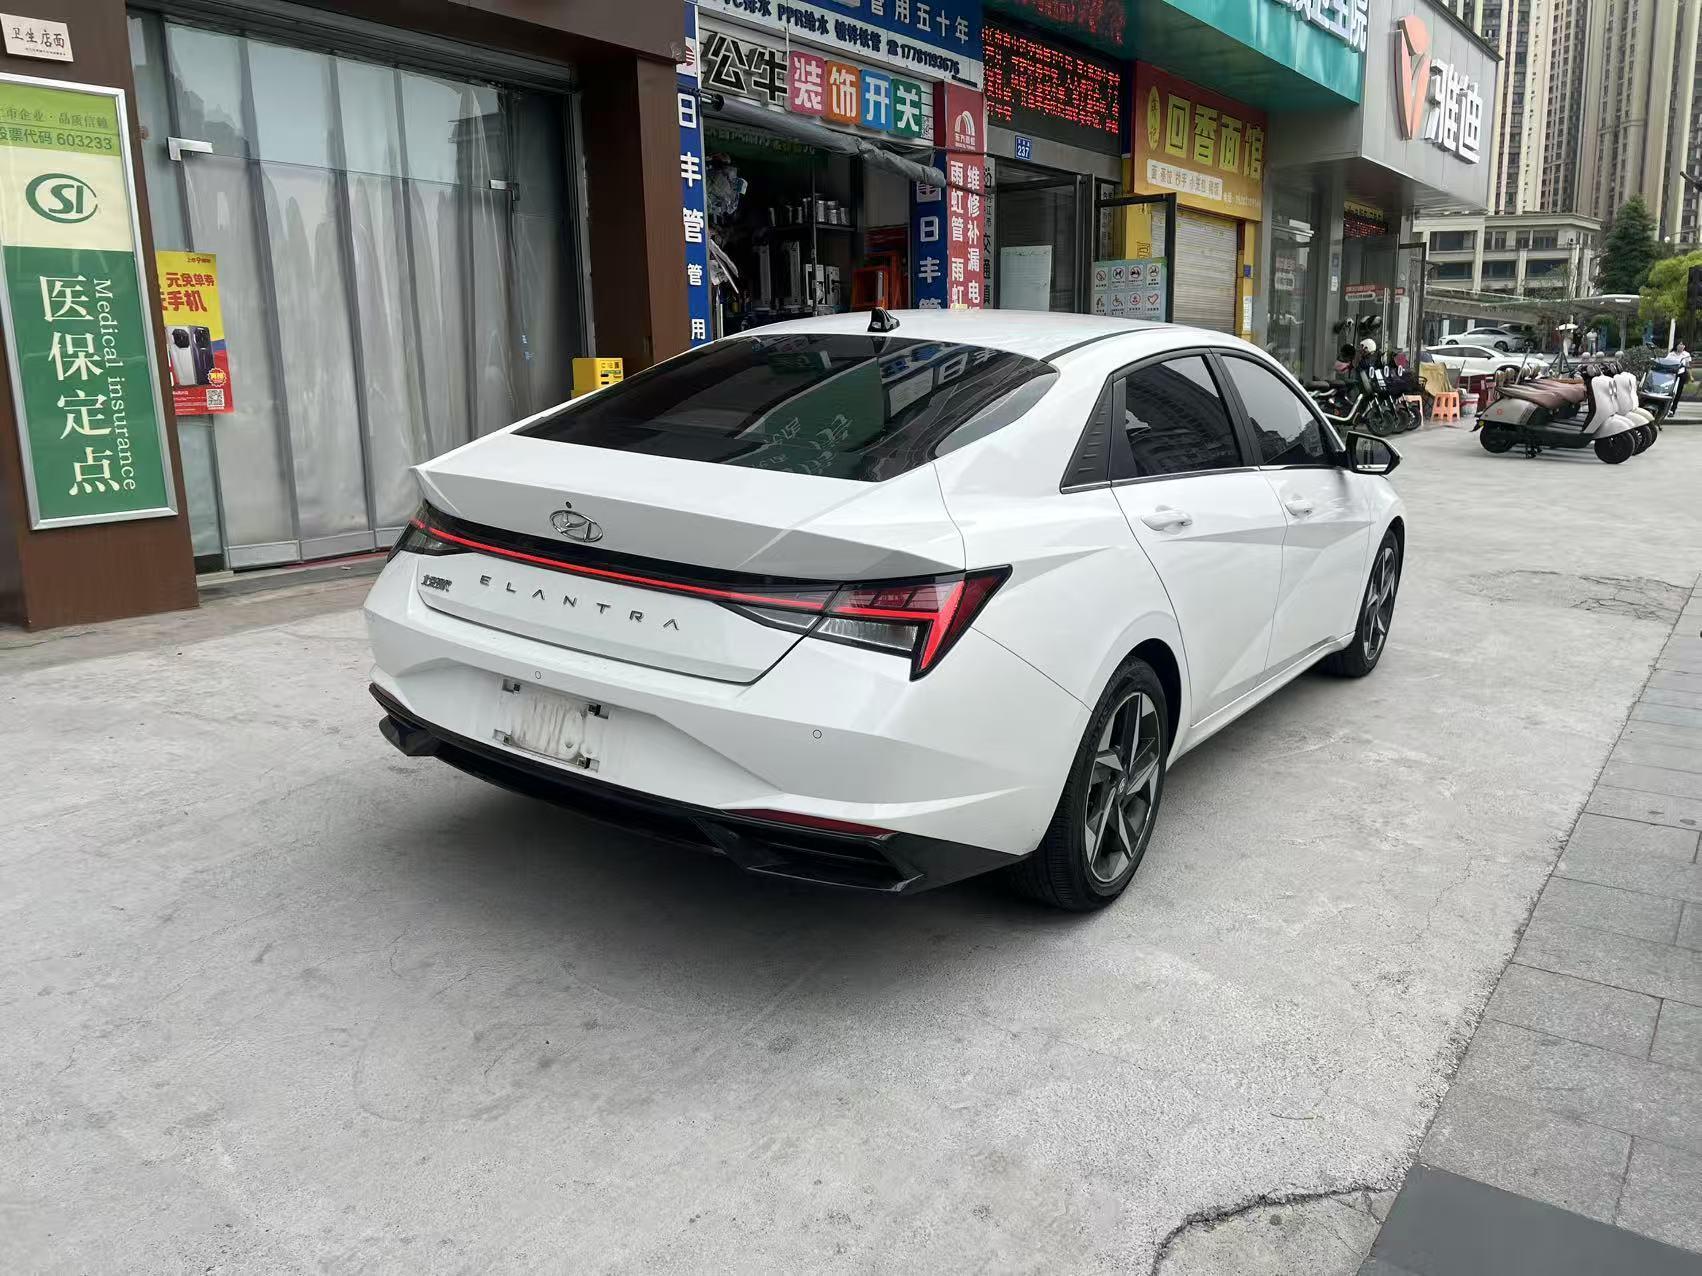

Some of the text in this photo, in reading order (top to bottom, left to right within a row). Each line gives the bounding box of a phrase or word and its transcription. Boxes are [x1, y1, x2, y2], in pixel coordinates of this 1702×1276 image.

[11, 27, 65, 48] 卫生店面
[708, 32, 788, 103] 公牛
[794, 56, 921, 131] 装饰开关
[56, 132, 112, 151] 603233
[1017, 144, 1030, 158] 237
[1424, 58, 1483, 164] 雅迪
[678, 92, 706, 340] 日丰管 管用
[951, 160, 964, 242] 雨虹管
[967, 165, 980, 272] 维修补漏
[38, 275, 121, 496] 医保定点
[93, 278, 136, 493] Medical insurance
[479, 574, 680, 631] ELANTRA
